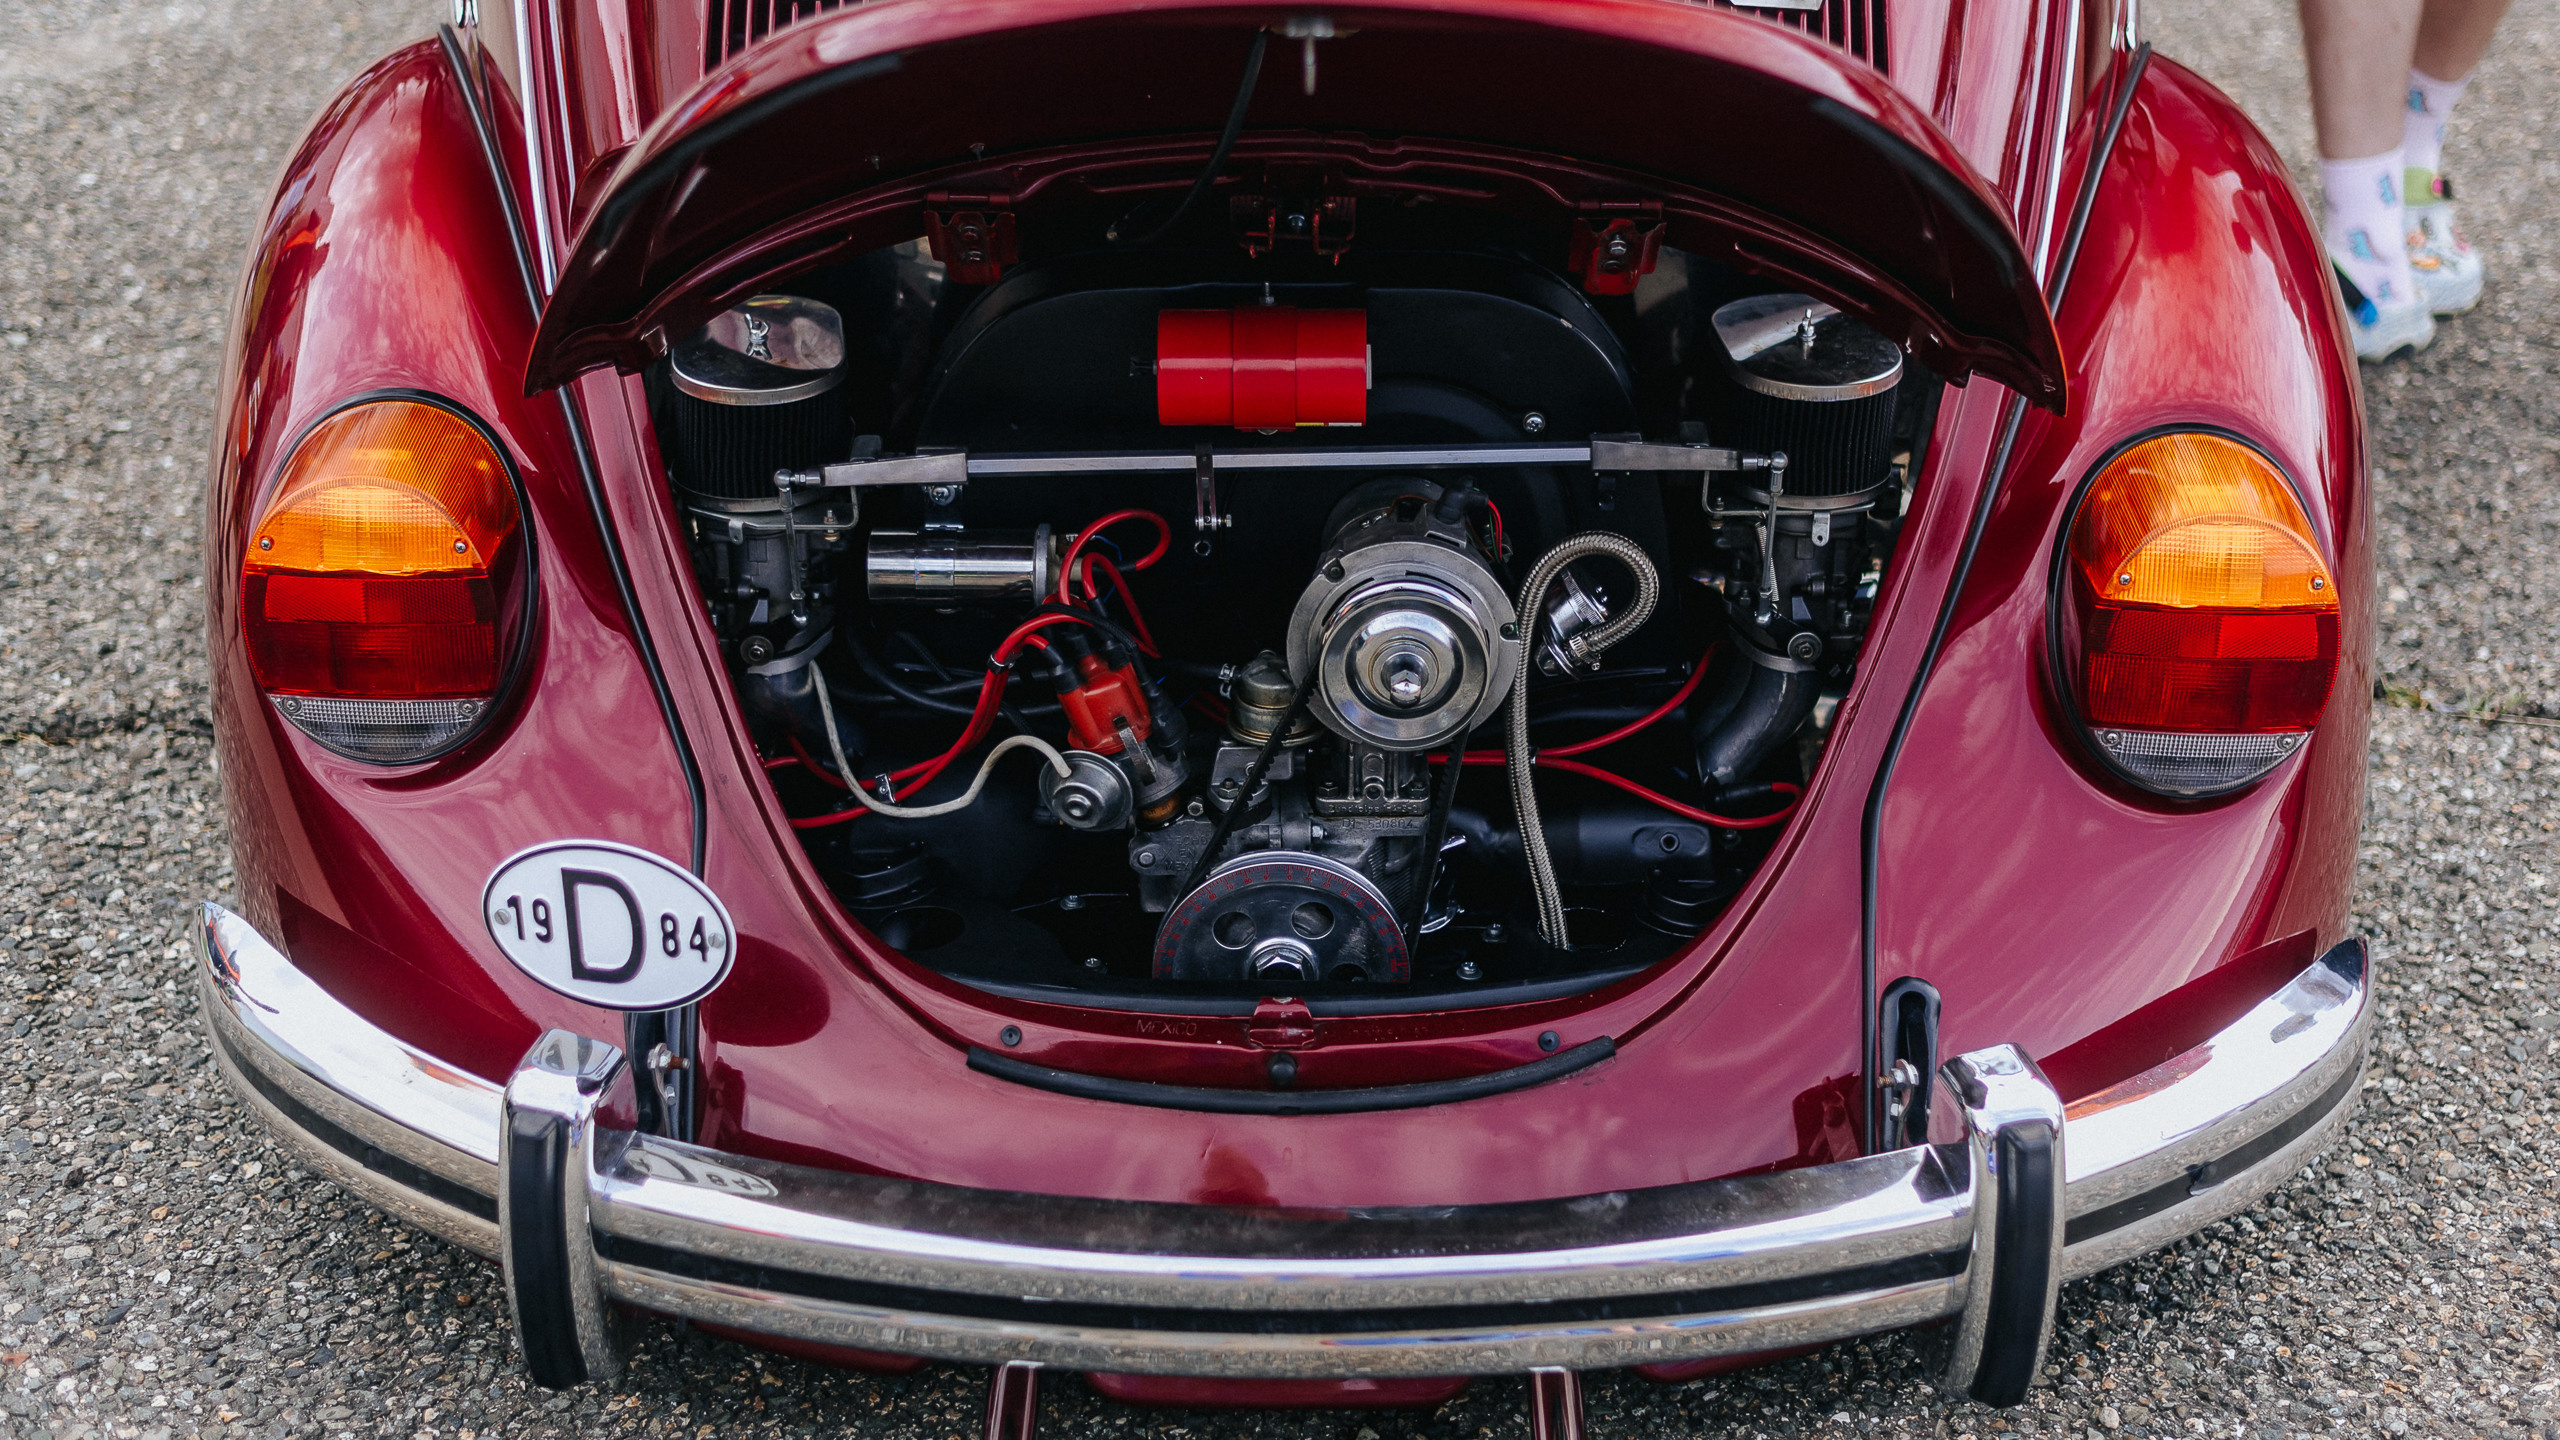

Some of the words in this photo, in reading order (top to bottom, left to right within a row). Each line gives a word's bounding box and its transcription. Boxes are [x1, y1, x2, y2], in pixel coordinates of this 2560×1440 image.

[507, 895, 553, 943] 19
[561, 867, 647, 983] D
[660, 912, 709, 963] 84
[1136, 1018, 1198, 1036] MEXICO
